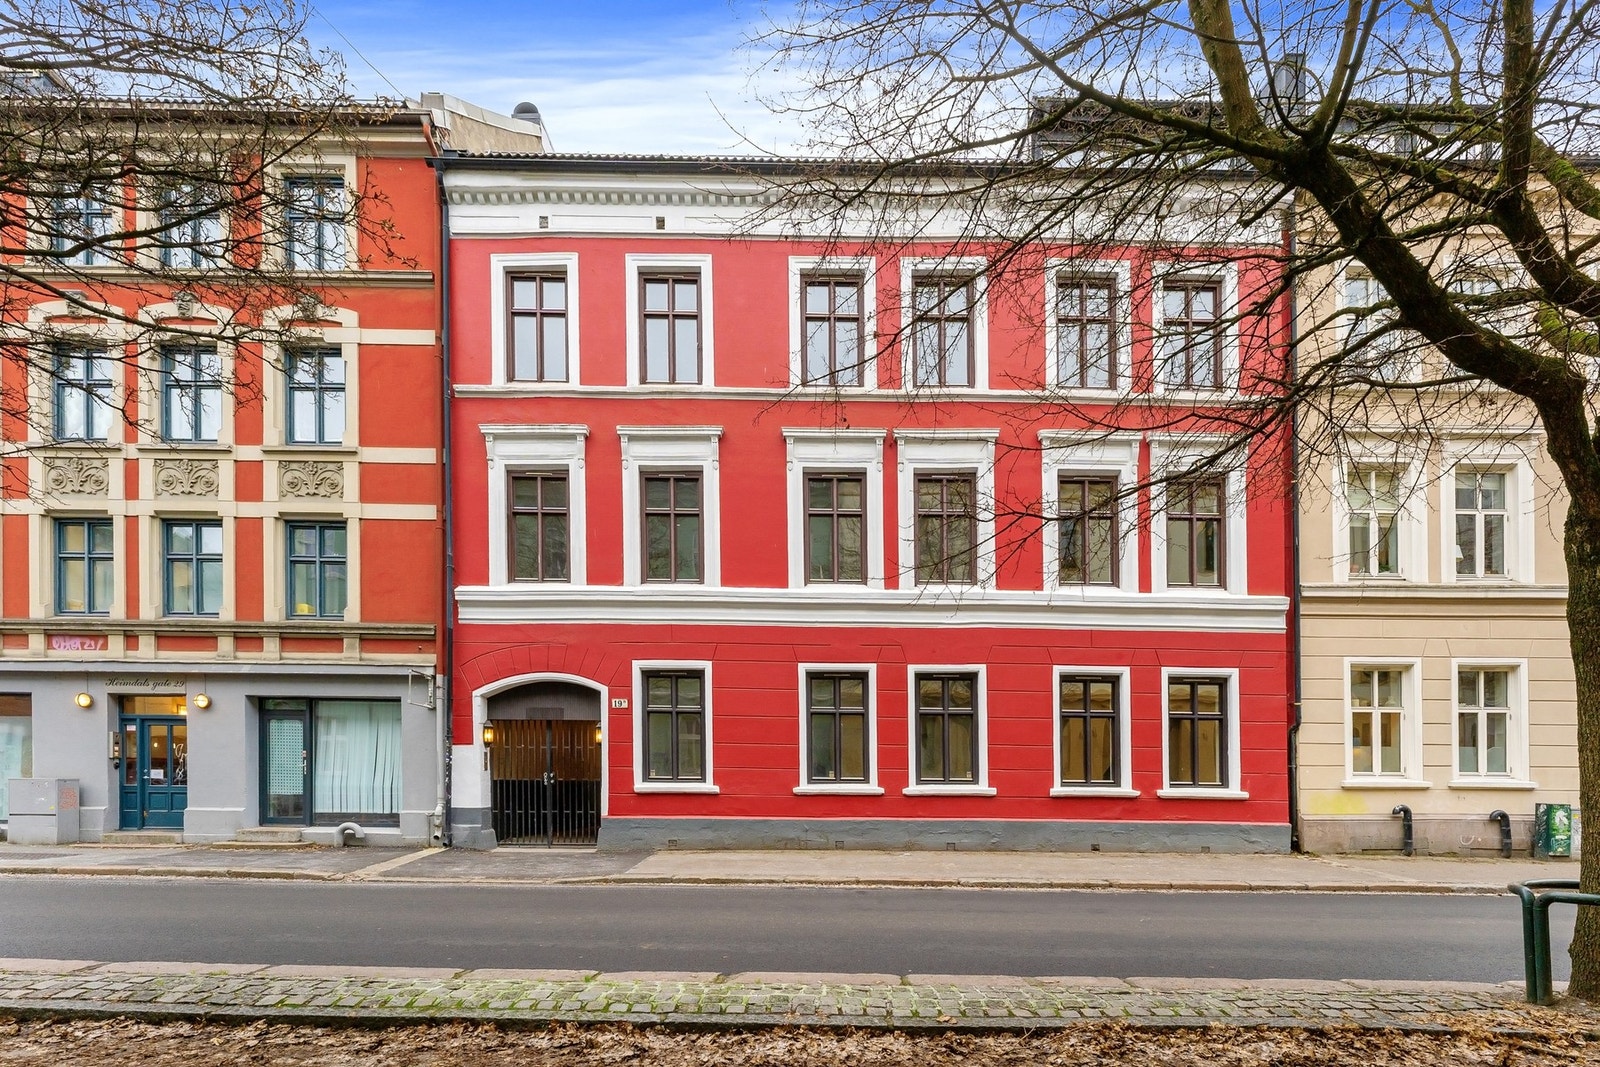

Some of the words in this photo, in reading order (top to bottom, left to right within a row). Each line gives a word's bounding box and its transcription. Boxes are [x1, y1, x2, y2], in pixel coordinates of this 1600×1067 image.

[105, 677, 150, 687] Heimdals
[151, 679, 171, 691] gate
[173, 680, 185, 688] 29
